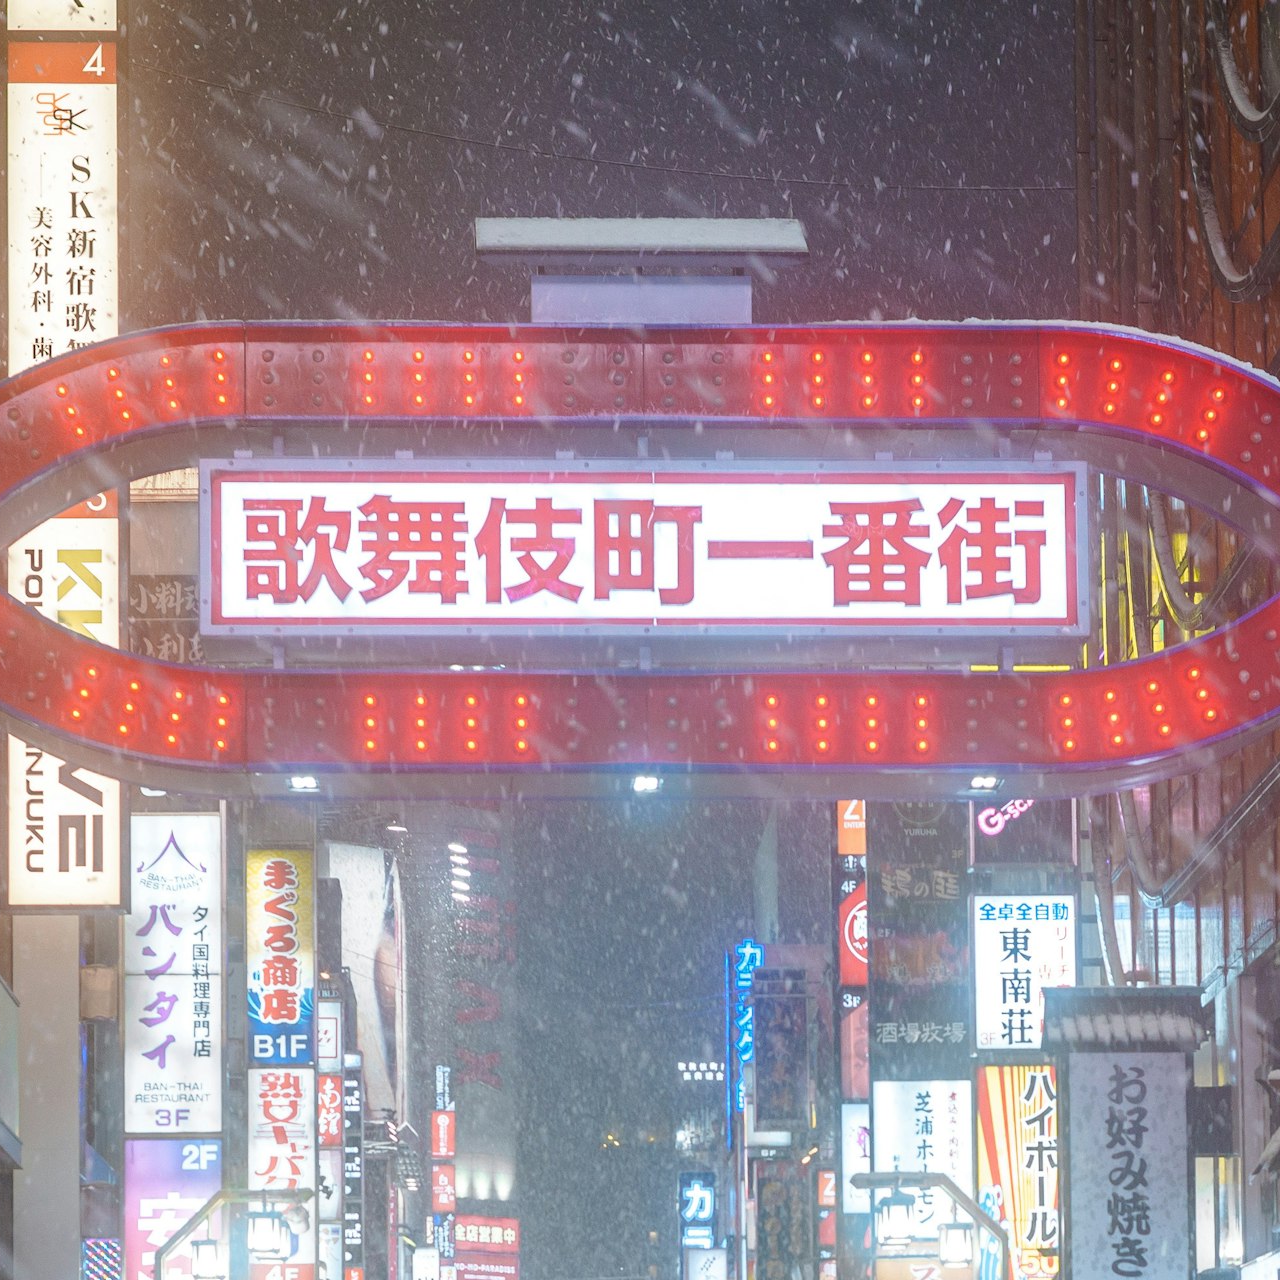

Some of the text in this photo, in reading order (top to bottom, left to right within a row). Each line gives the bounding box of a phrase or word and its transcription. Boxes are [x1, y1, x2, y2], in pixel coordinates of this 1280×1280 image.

[83, 46, 106, 76] 4
[242, 495, 1048, 607] 歌舞伎町一番街
[841, 880, 856, 893] 4F
[979, 903, 1069, 921] 全卓全自動
[261, 860, 301, 1022] まぐろ商店
[135, 904, 183, 1070] バンタイ
[193, 905, 211, 1058] タイ国料理専門店
[999, 927, 1034, 1045] 東南荘
[253, 1034, 308, 1058] B1F
[136, 1093, 211, 1103] RESTAURANT
[144, 1082, 203, 1092] BAN-THAI
[155, 1109, 191, 1127] 3F
[182, 1145, 218, 1170] 2F
[914, 1090, 935, 1223] 芝浦ホモン
[1024, 1073, 1058, 1242] ハイボール
[1105, 1064, 1150, 1279] お好み焼き
